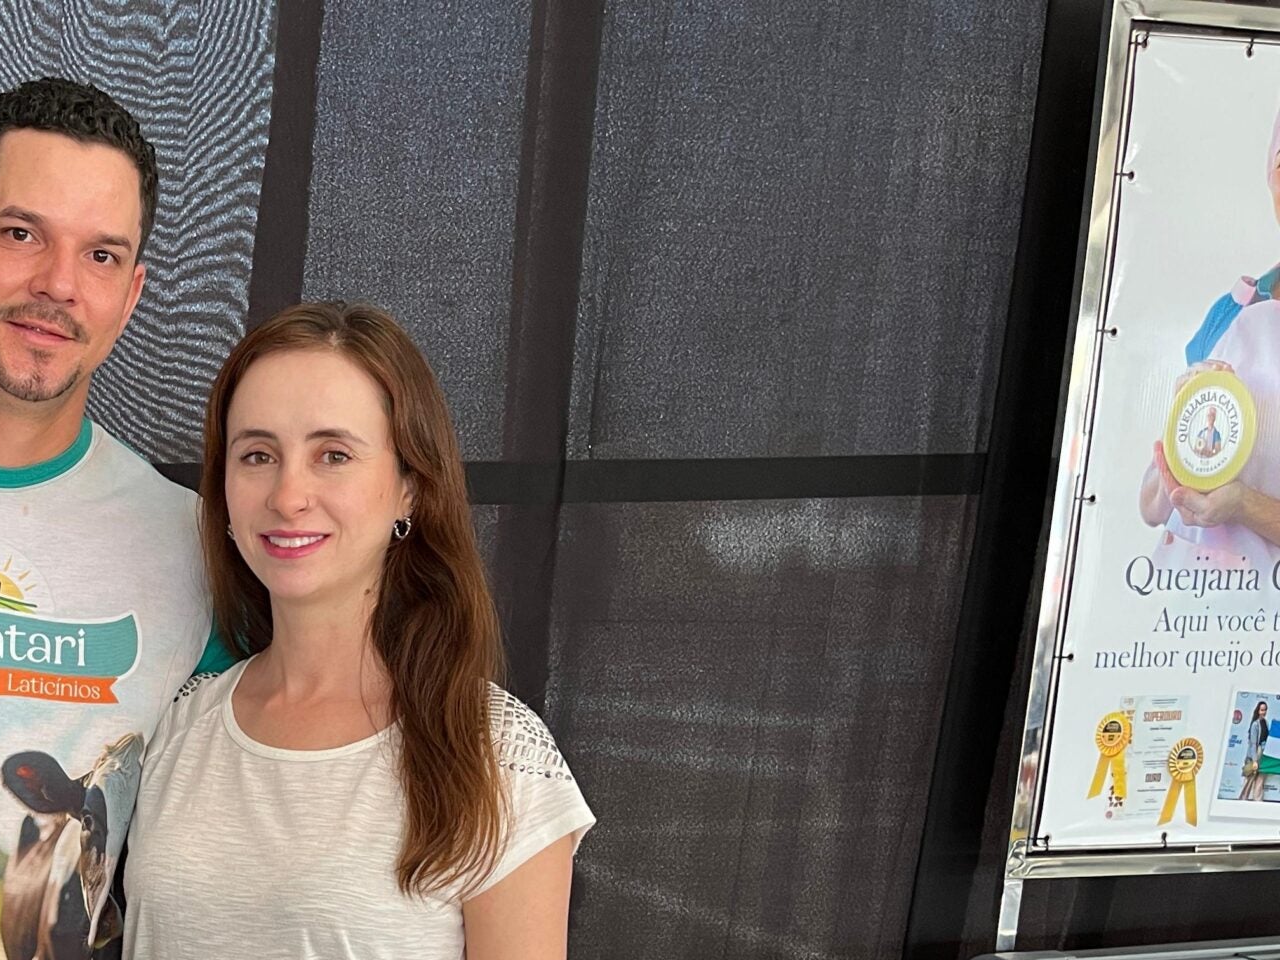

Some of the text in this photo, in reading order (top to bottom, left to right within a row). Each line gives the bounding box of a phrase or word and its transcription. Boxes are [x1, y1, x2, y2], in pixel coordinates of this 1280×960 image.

[1125, 555, 1261, 598] Queijaria
[1152, 606, 1210, 639] Aqui
[1217, 608, 1266, 632] você
[1094, 641, 1179, 668] melhor
[1185, 640, 1253, 673] queijo
[7, 673, 101, 700] Laticínios
